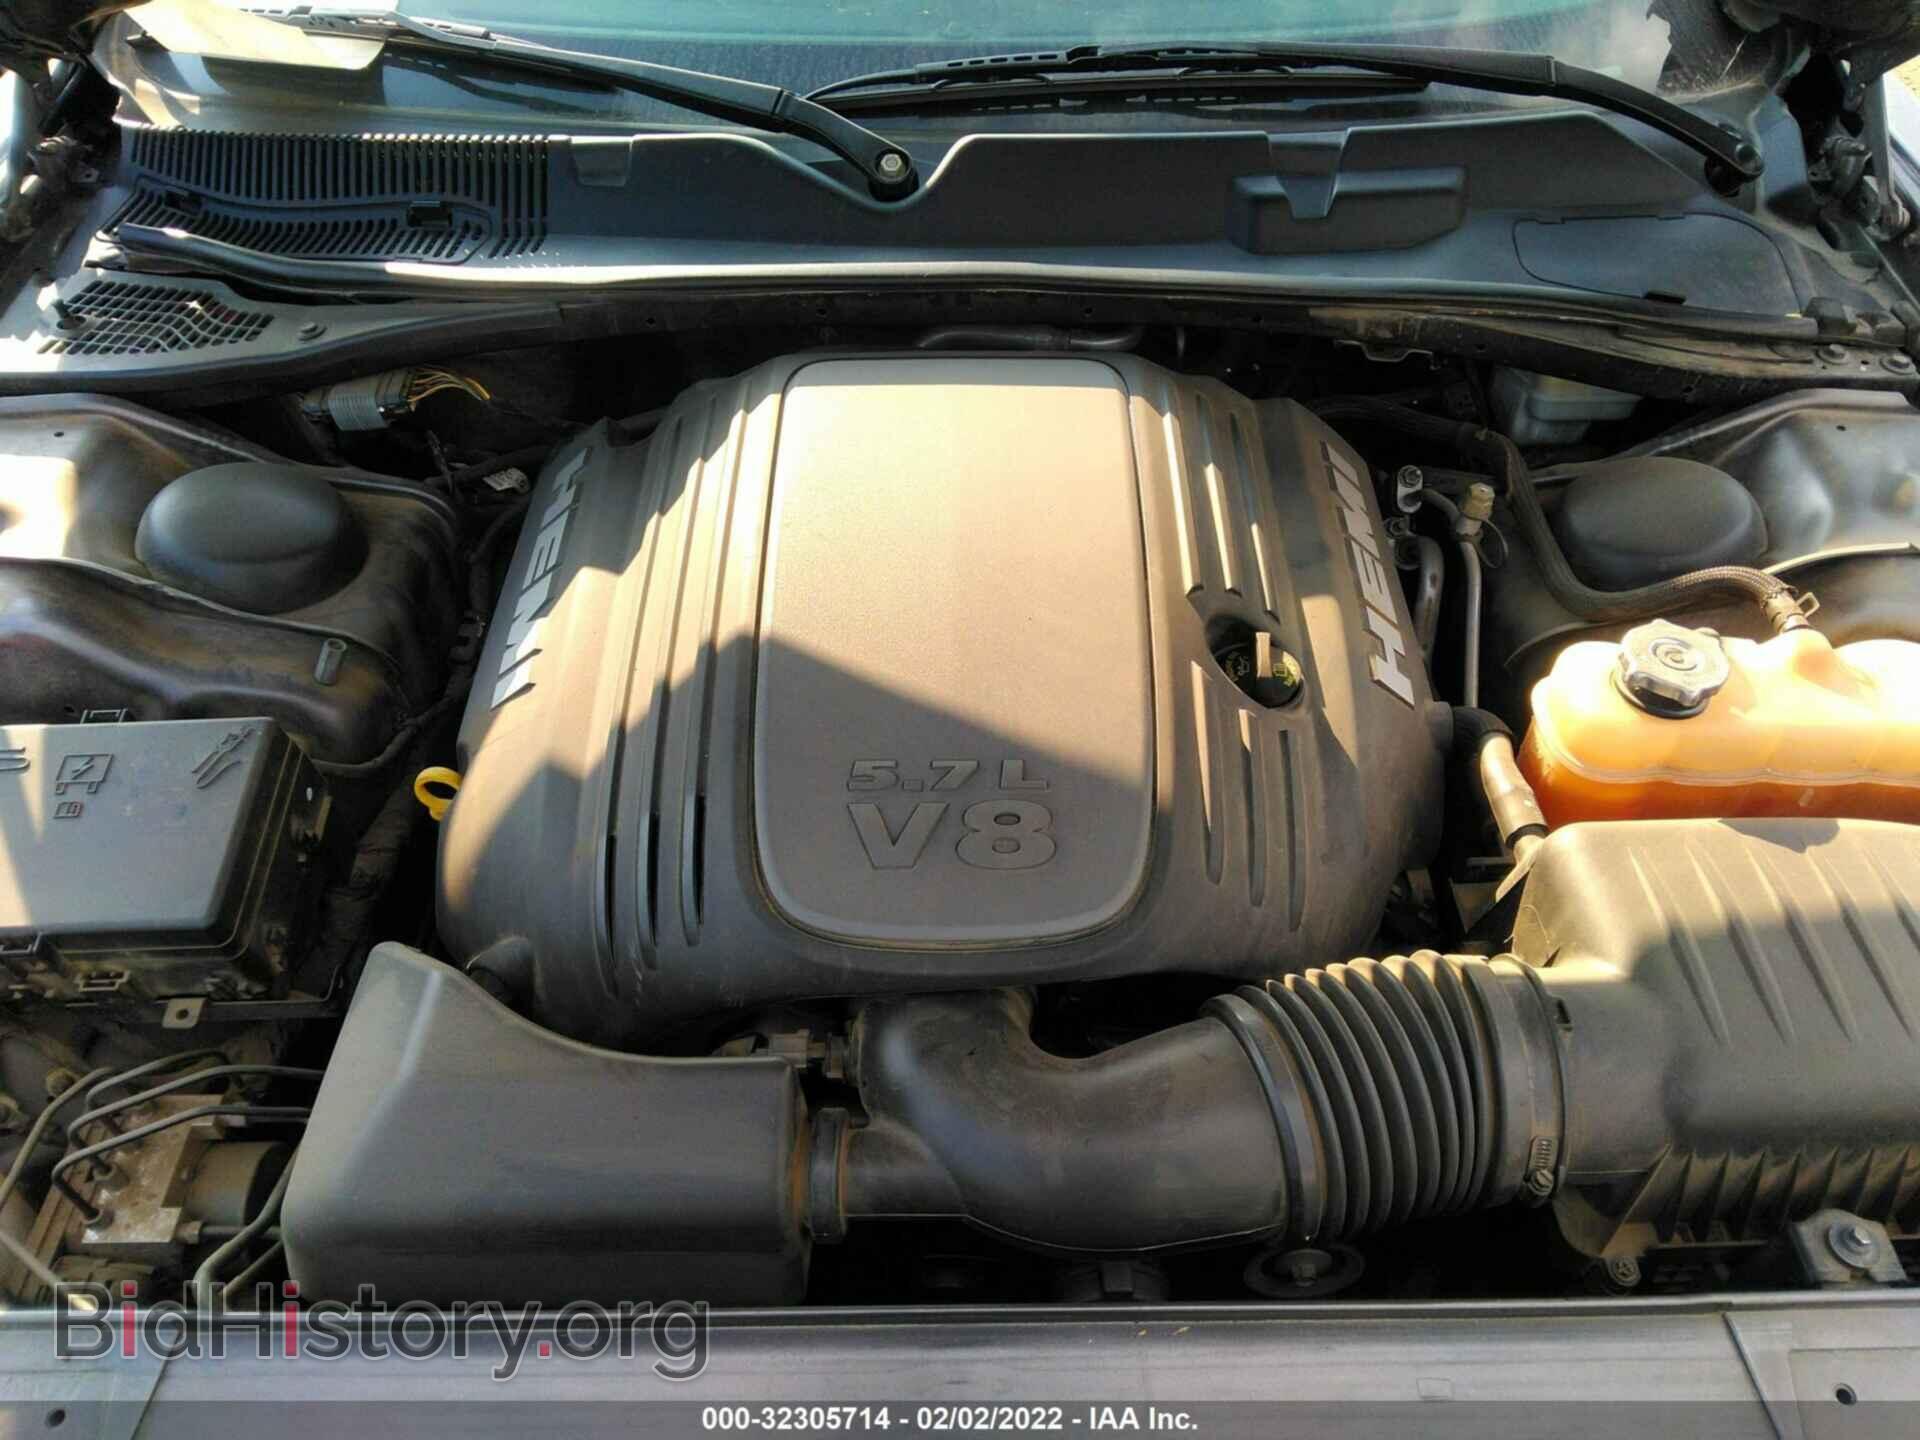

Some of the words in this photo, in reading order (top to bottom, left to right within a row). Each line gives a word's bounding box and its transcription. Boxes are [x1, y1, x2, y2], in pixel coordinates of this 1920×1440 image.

[490, 447, 590, 712] HEMI
[1320, 440, 1416, 709] HEMI
[846, 799, 1057, 871] V8
